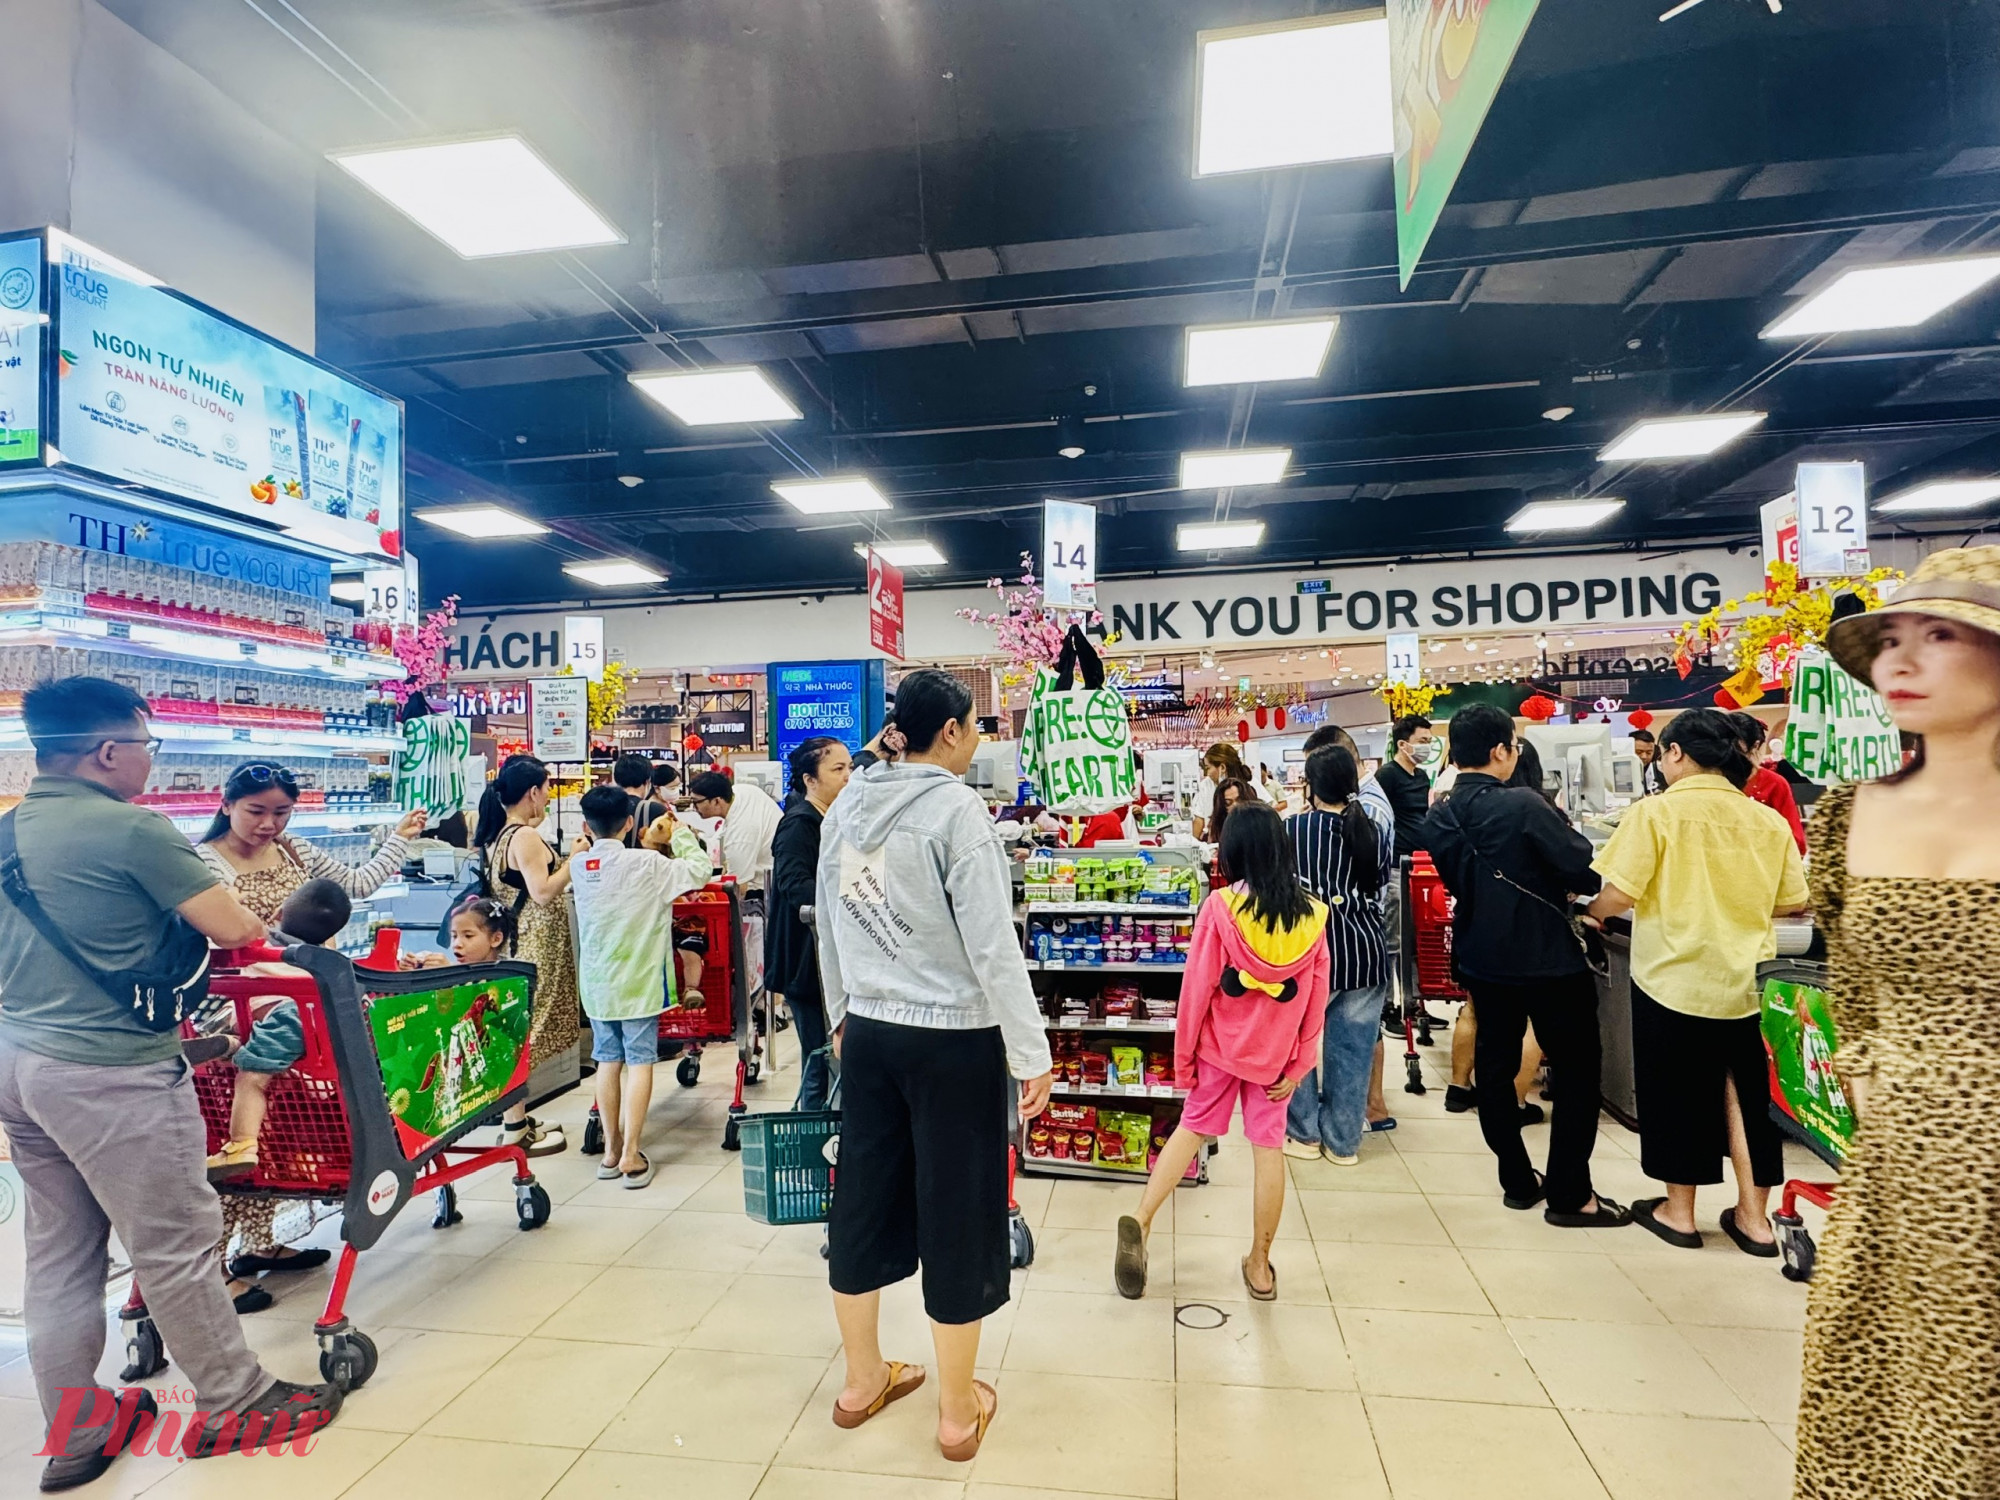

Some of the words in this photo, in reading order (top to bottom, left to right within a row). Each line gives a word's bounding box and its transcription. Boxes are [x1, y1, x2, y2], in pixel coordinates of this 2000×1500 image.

[64, 264, 108, 299] true
[64, 282, 108, 310] YOGURT
[92, 330, 152, 364] NGON
[158, 352, 184, 378] TỰ
[188, 365, 244, 407] NHIÊN
[104, 362, 144, 385] TRÀN
[270, 438, 292, 456] true
[313, 450, 340, 472] true
[359, 470, 378, 487] true
[1812, 506, 1854, 534] 12
[69, 513, 129, 555] TH
[159, 528, 230, 576] true
[235, 552, 323, 598] YOGURT
[1053, 541, 1087, 570] 14
[372, 586, 398, 609] 16
[407, 588, 416, 613] 16
[1086, 601, 1182, 643] ANK
[1192, 595, 1300, 638] YOU
[1317, 589, 1420, 634] FOR
[1432, 572, 1722, 627] SHOPPING
[444, 623, 560, 670] HÁCH
[572, 642, 596, 659] 15
[1392, 654, 1414, 668] 11
[805, 682, 824, 692] NHÀ
[824, 681, 854, 690] THUỐC
[788, 702, 850, 718] HOTLINE
[784, 718, 812, 730] 0704
[812, 718, 833, 729] 156
[833, 717, 854, 728] 239
[1838, 734, 1901, 780] EARTH
[840, 894, 898, 962] Adwahoshot
[1050, 1109, 1085, 1120] Skittles
